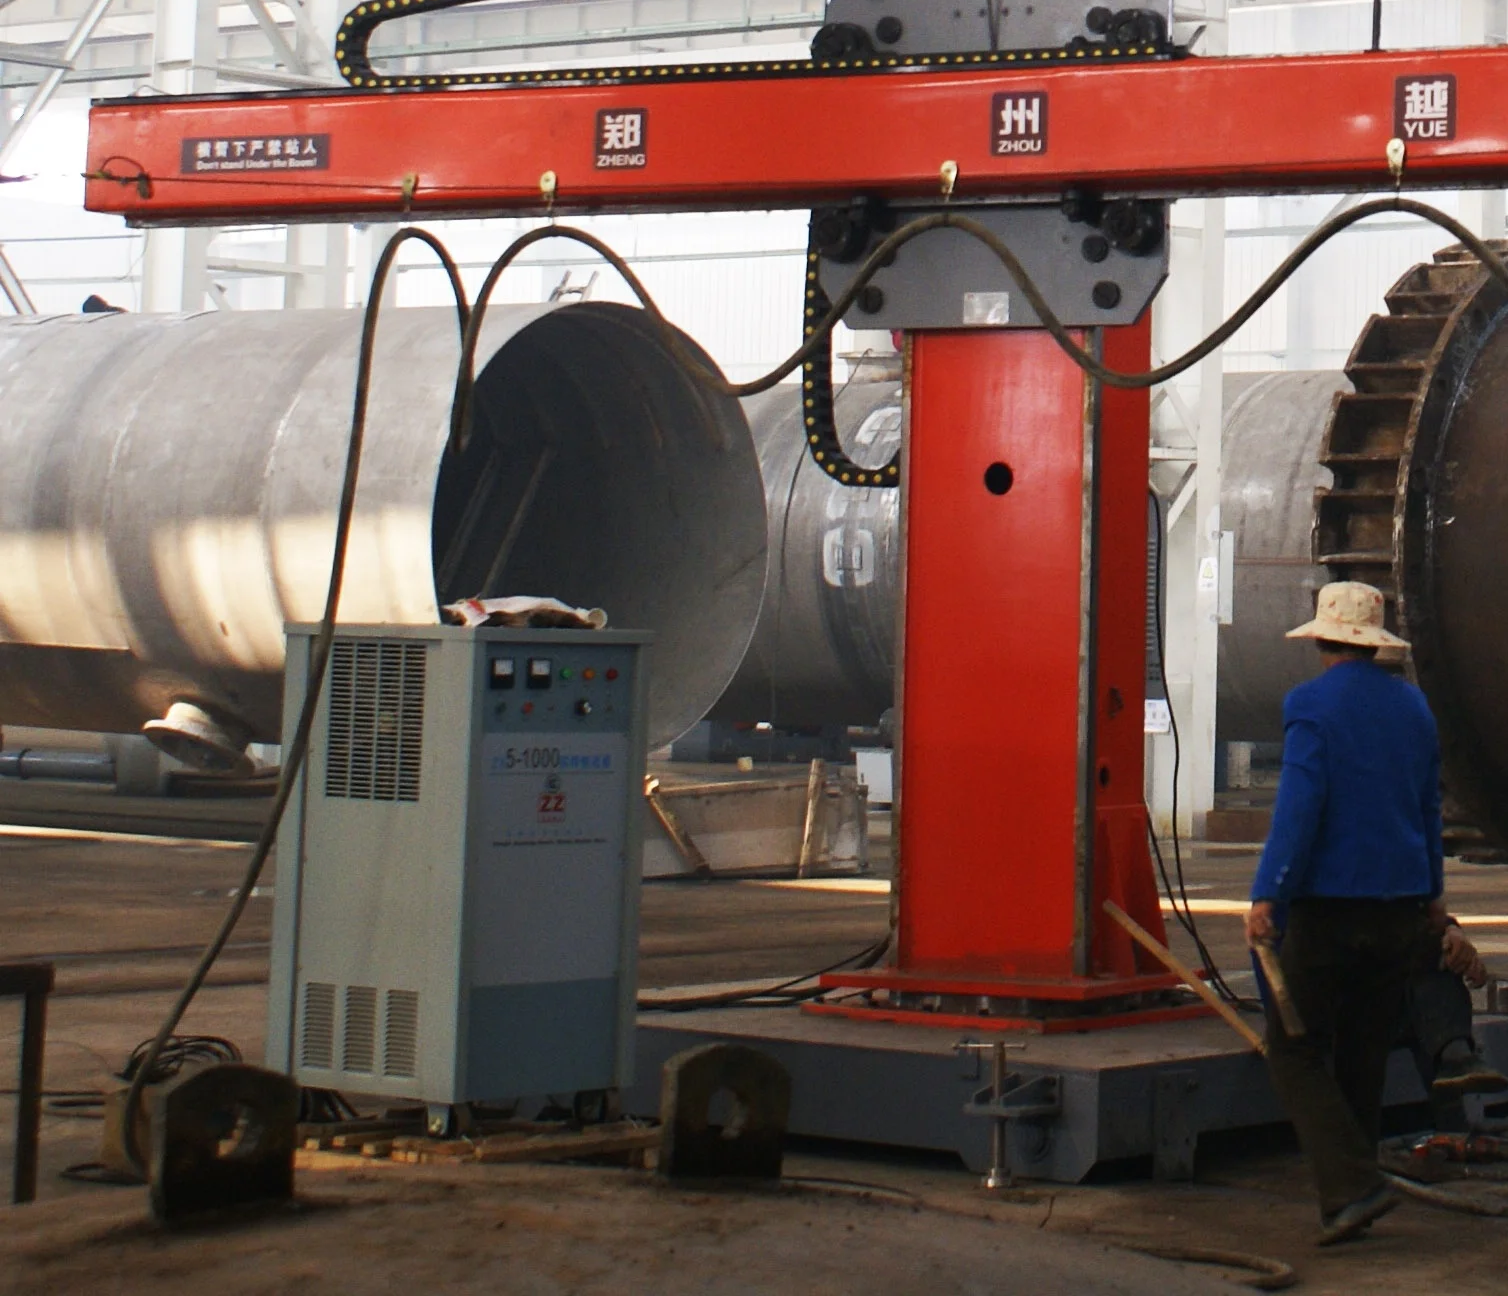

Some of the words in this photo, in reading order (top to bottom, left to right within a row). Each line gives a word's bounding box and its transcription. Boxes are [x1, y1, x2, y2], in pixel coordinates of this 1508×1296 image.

[999, 98, 1040, 135] 州
[603, 114, 642, 149] 郑
[1403, 120, 1448, 138] YUE
[196, 138, 317, 158] 横臂下严禁站人
[998, 139, 1042, 153] ZHOU
[220, 159, 245, 170] stand
[245, 158, 272, 169] Under
[272, 159, 288, 168] the
[597, 154, 646, 167] ZHENG
